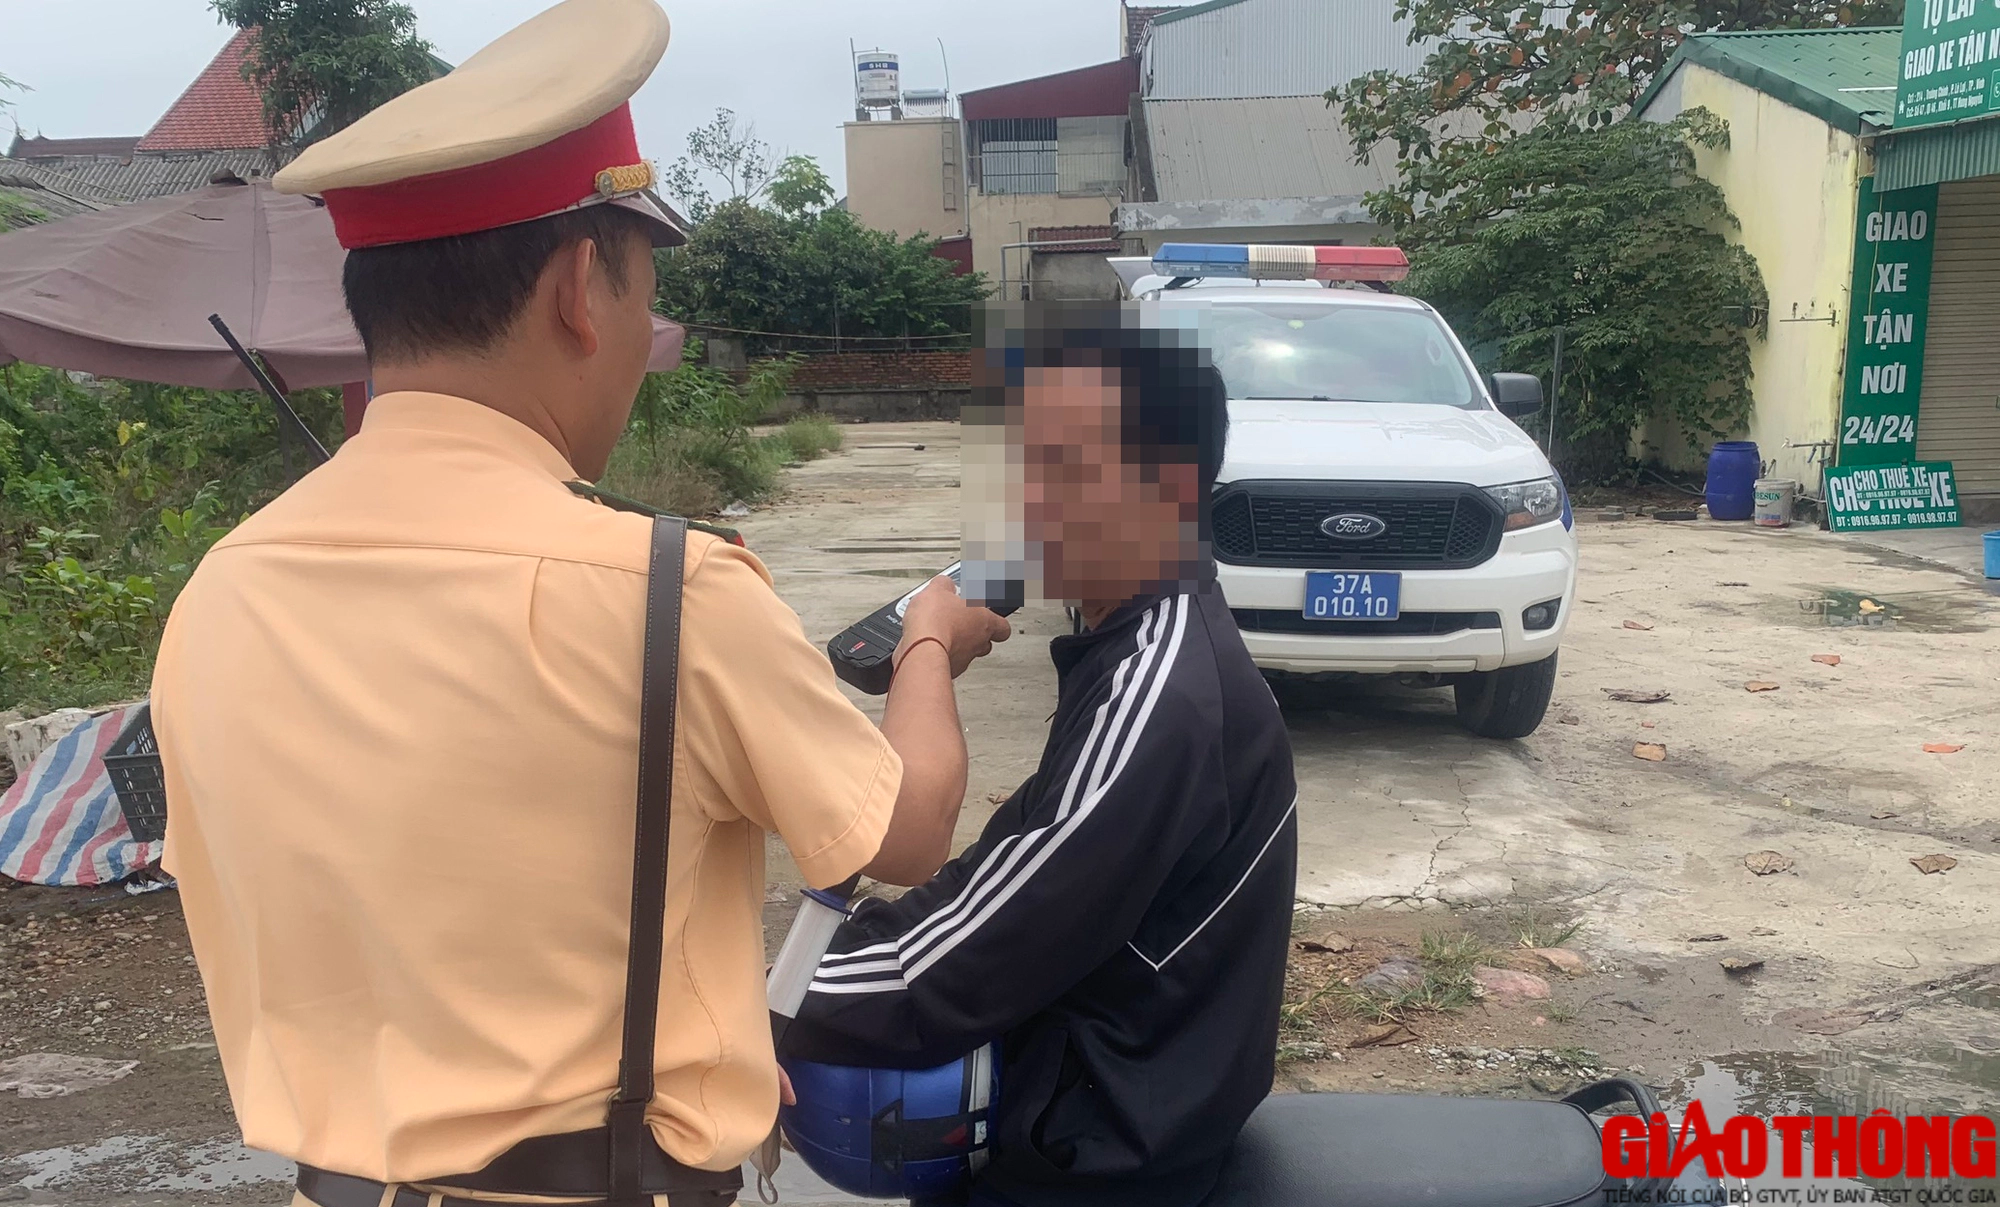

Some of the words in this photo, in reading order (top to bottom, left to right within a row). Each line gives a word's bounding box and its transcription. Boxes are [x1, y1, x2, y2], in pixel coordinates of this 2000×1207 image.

[1904, 44, 1935, 80] GIAO
[1937, 40, 1955, 72] XE
[1958, 29, 1986, 71] TẬN
[1988, 27, 2000, 60] N
[1865, 210, 1927, 242] GIAO
[1874, 262, 1908, 293] XE
[1863, 308, 1913, 350] TẬN
[1860, 361, 1907, 394] NƠI
[1843, 414, 1914, 445] 24/24
[1853, 469, 1878, 492] CHO
[1879, 464, 1910, 489] THUÊ
[1911, 466, 1928, 487] XE
[1928, 471, 1955, 508] XE
[1335, 517, 1371, 533] Ford
[1851, 514, 1900, 527] 0916.96.97.97
[1332, 574, 1372, 595] 37A
[1314, 596, 1388, 617] 010.10
